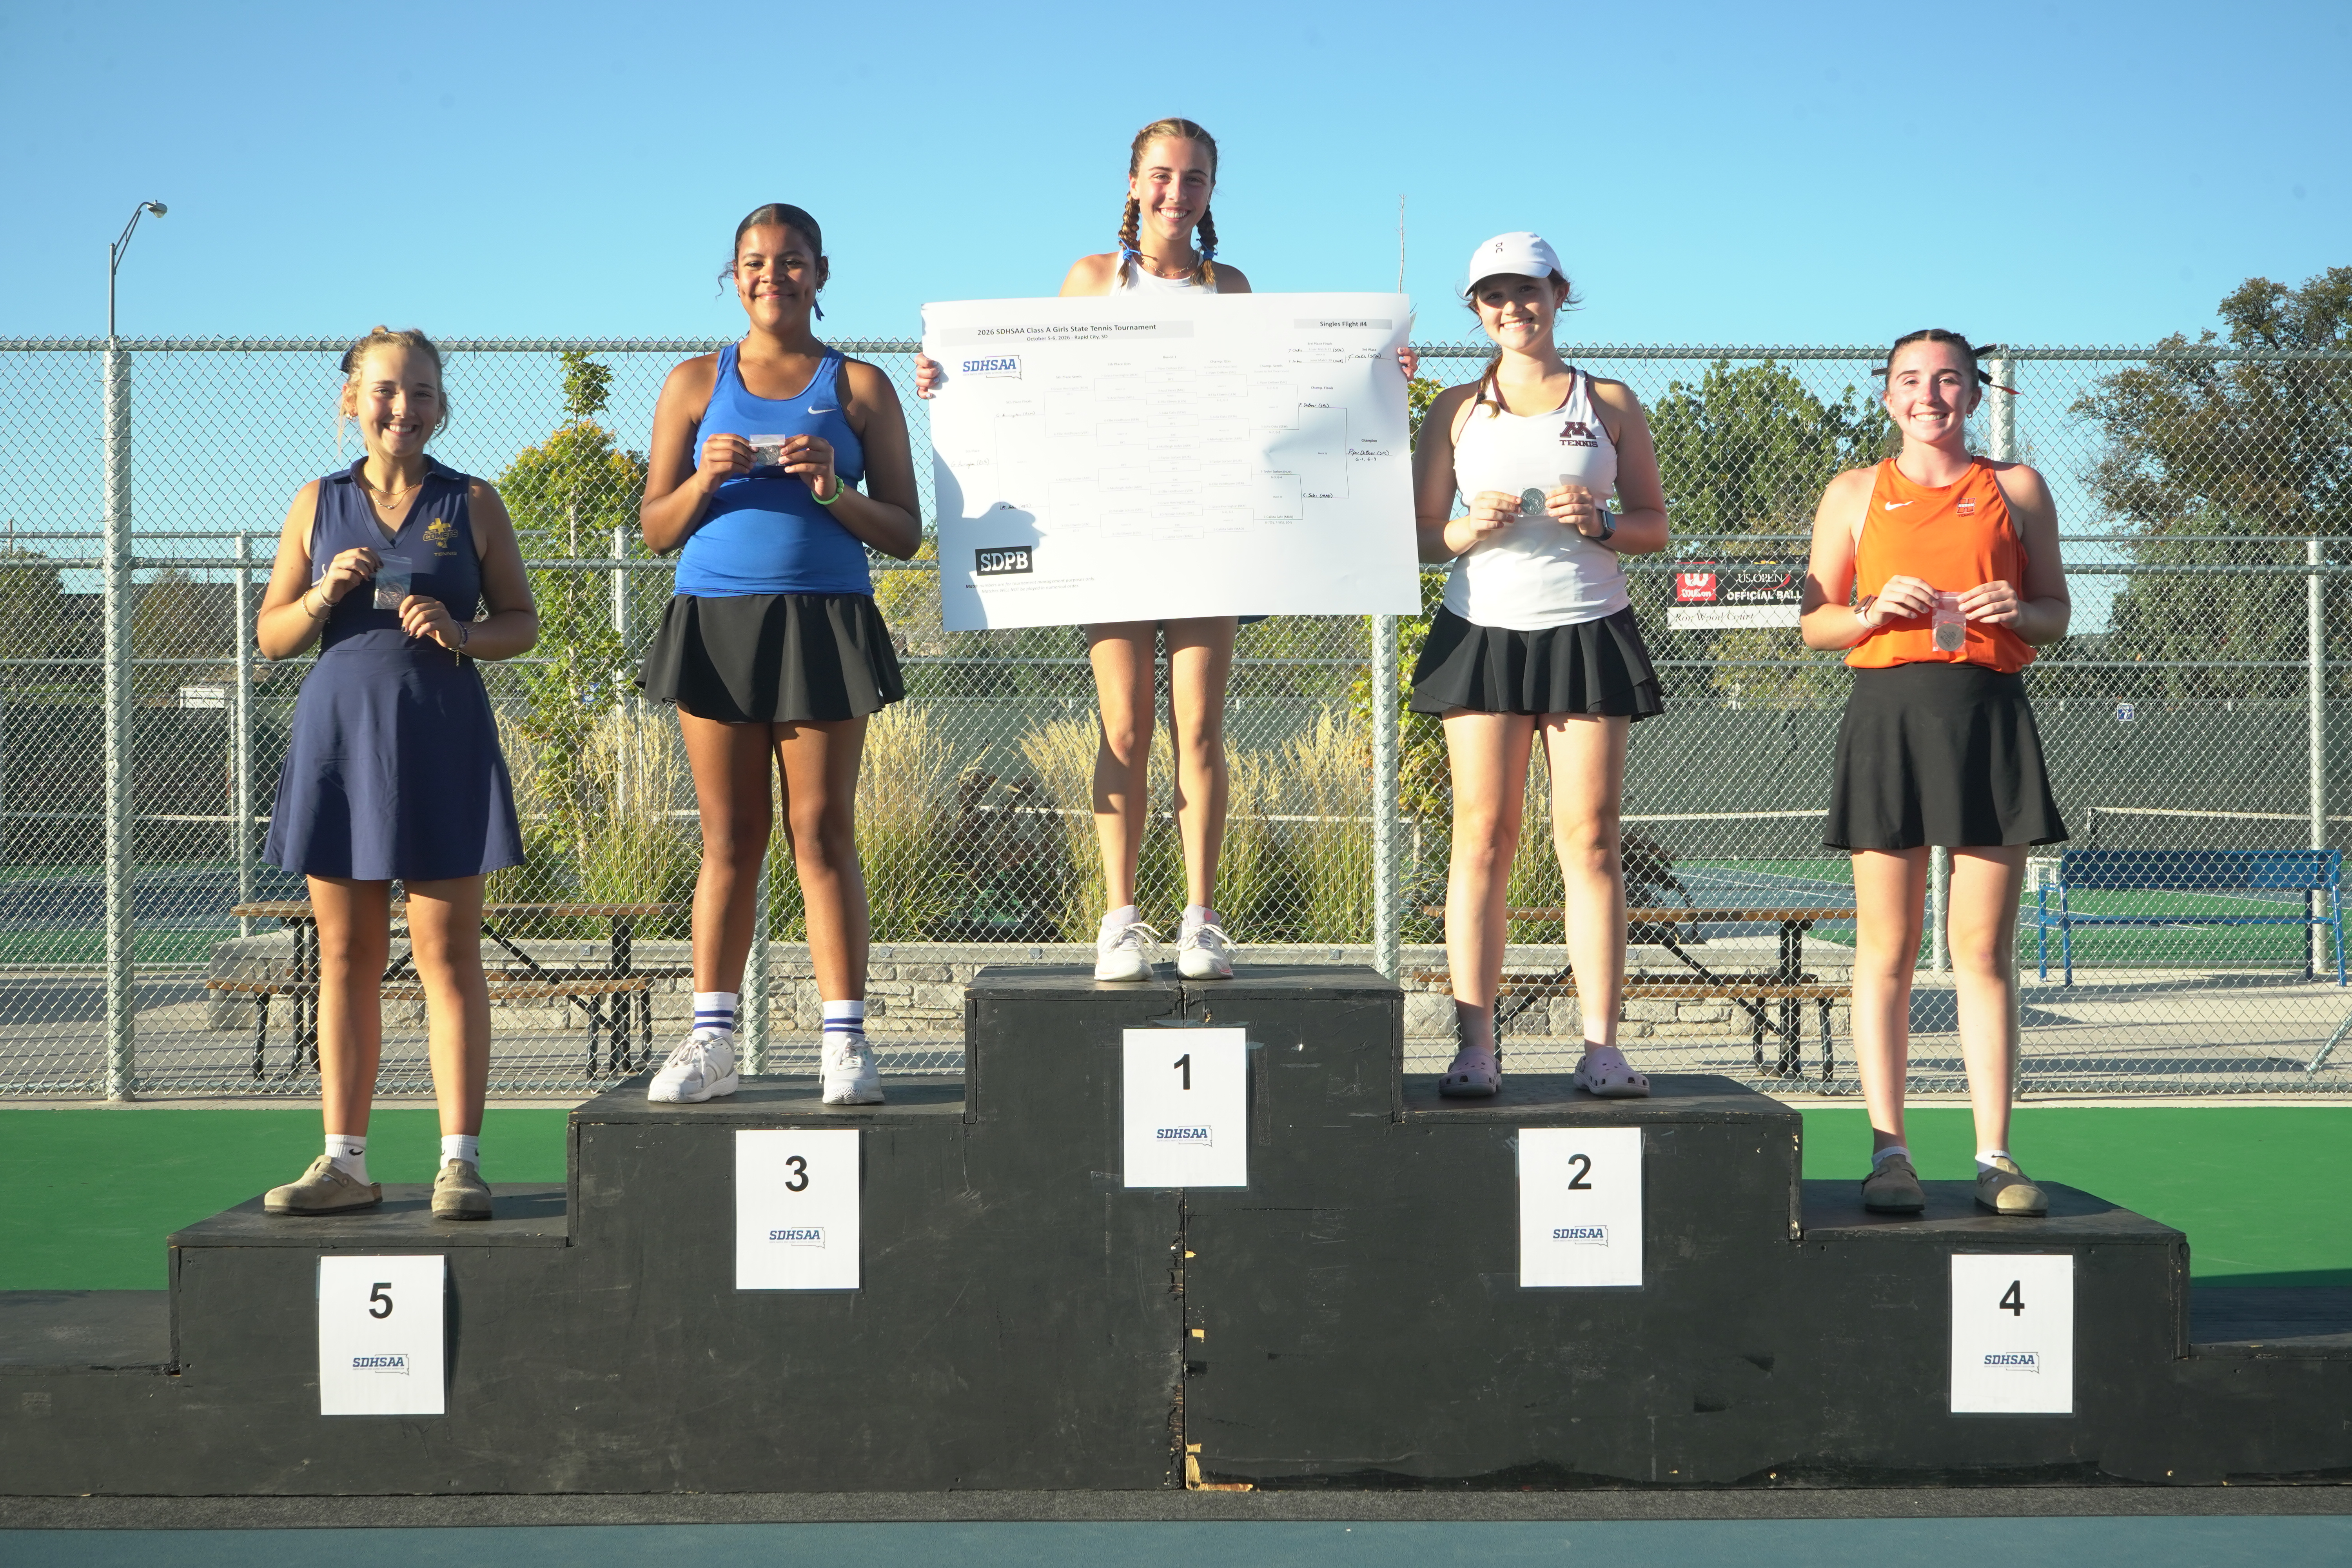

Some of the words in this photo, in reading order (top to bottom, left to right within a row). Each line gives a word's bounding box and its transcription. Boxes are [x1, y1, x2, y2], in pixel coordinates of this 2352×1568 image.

[963, 359, 1016, 372] SDHSAA
[1560, 421, 1596, 439] M
[423, 529, 458, 541] COMETS
[981, 551, 1028, 572] SDPB
[1737, 573, 1750, 583] US
[1752, 573, 1783, 583] OPEN
[1682, 589, 1711, 597] Wilson
[1727, 591, 1774, 601] OFFICIAL
[1777, 590, 1802, 599] BALL
[1174, 1054, 1190, 1090] 1
[1157, 1129, 1207, 1138] SDHSAA
[785, 1156, 809, 1192] 3
[1568, 1154, 1591, 1189] 2
[769, 1230, 820, 1240] SDHSAA
[1553, 1229, 1603, 1238] SDHSAA
[369, 1283, 393, 1319] 5
[2000, 1280, 2025, 1316] 4
[353, 1357, 404, 1367] SDHSAA
[1984, 1355, 2034, 1364] SDHSAA
